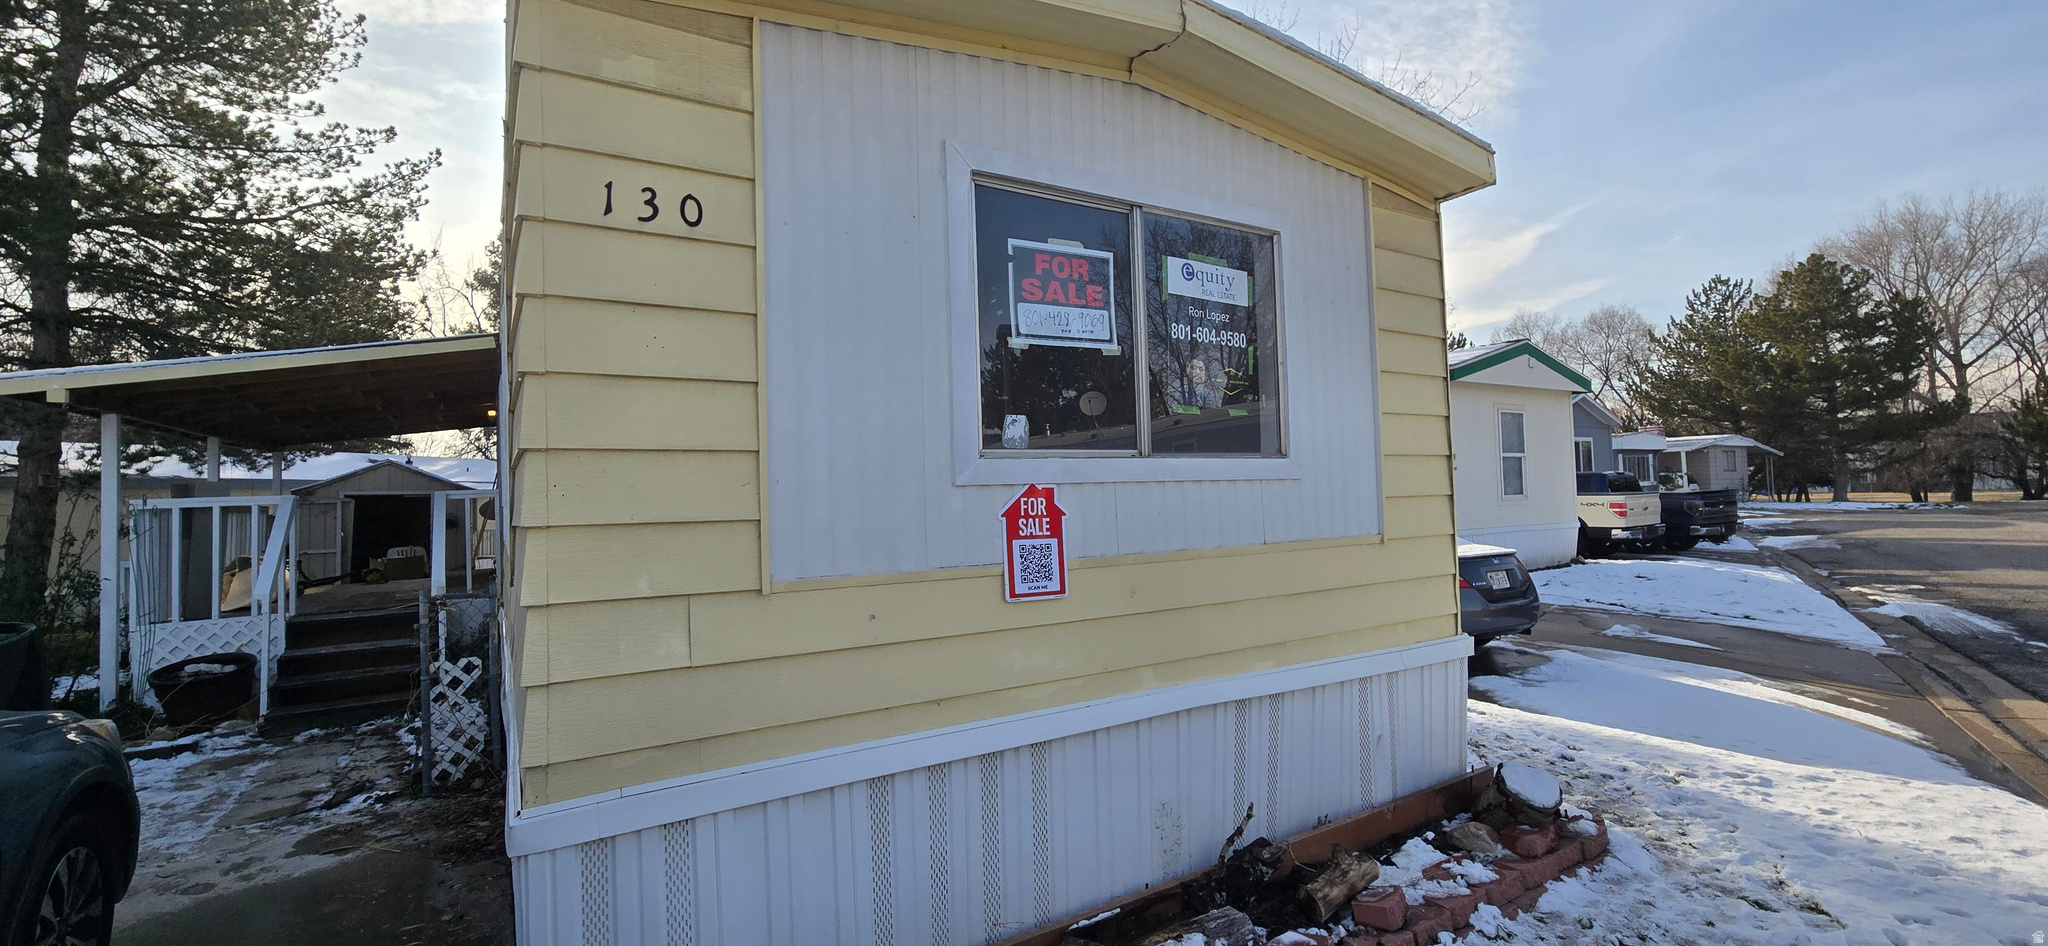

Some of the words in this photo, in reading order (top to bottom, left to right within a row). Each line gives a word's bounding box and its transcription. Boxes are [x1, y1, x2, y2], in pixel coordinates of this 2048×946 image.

[603, 180, 703, 228] 130
[1035, 253, 1089, 281] FOR
[1181, 262, 1235, 291] equity
[1021, 277, 1104, 307] SALE
[1202, 289, 1215, 298] REAL
[1217, 292, 1236, 301] ESTATE
[1188, 306, 1204, 318] Ron
[1206, 308, 1230, 323] Lopez
[1171, 322, 1247, 348] 801-604-9580
[1020, 497, 1047, 516] FOR
[1018, 517, 1051, 537] SALE
